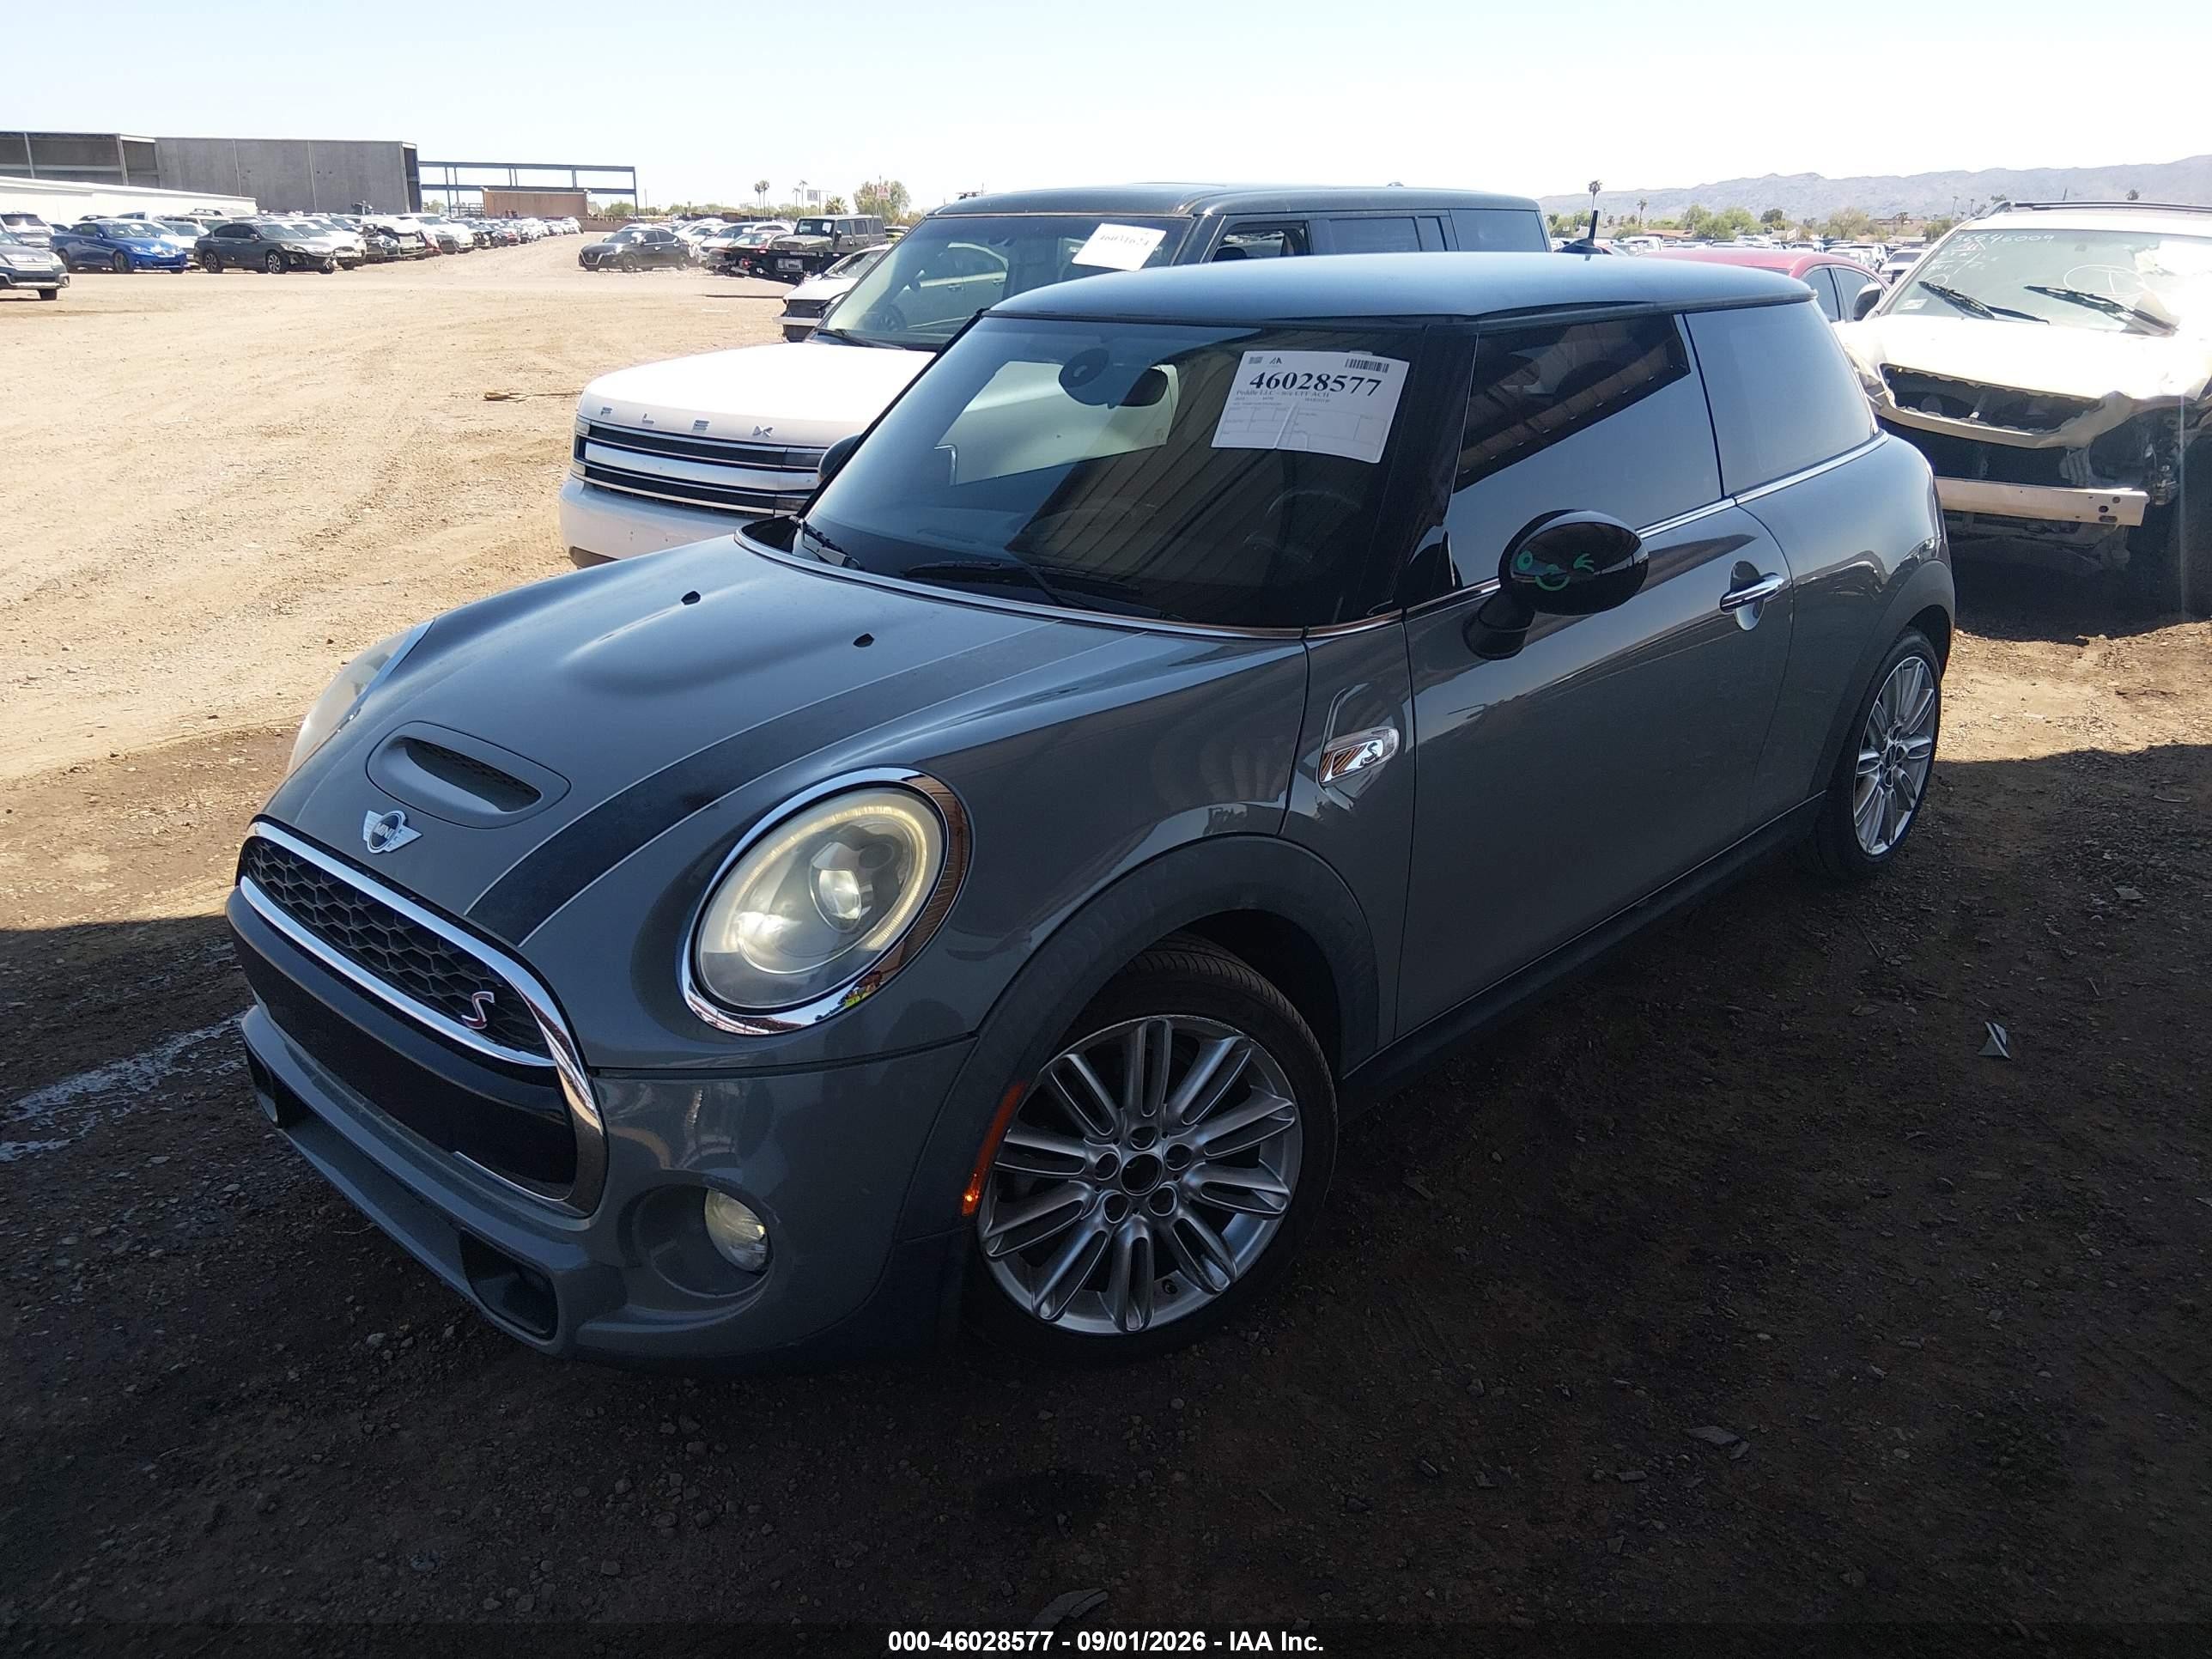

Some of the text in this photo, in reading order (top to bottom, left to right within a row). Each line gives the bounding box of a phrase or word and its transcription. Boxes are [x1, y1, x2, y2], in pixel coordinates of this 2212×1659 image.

[1249, 372, 1382, 397] 46028577
[374, 822, 396, 840] MINI
[460, 990, 495, 1030] S
